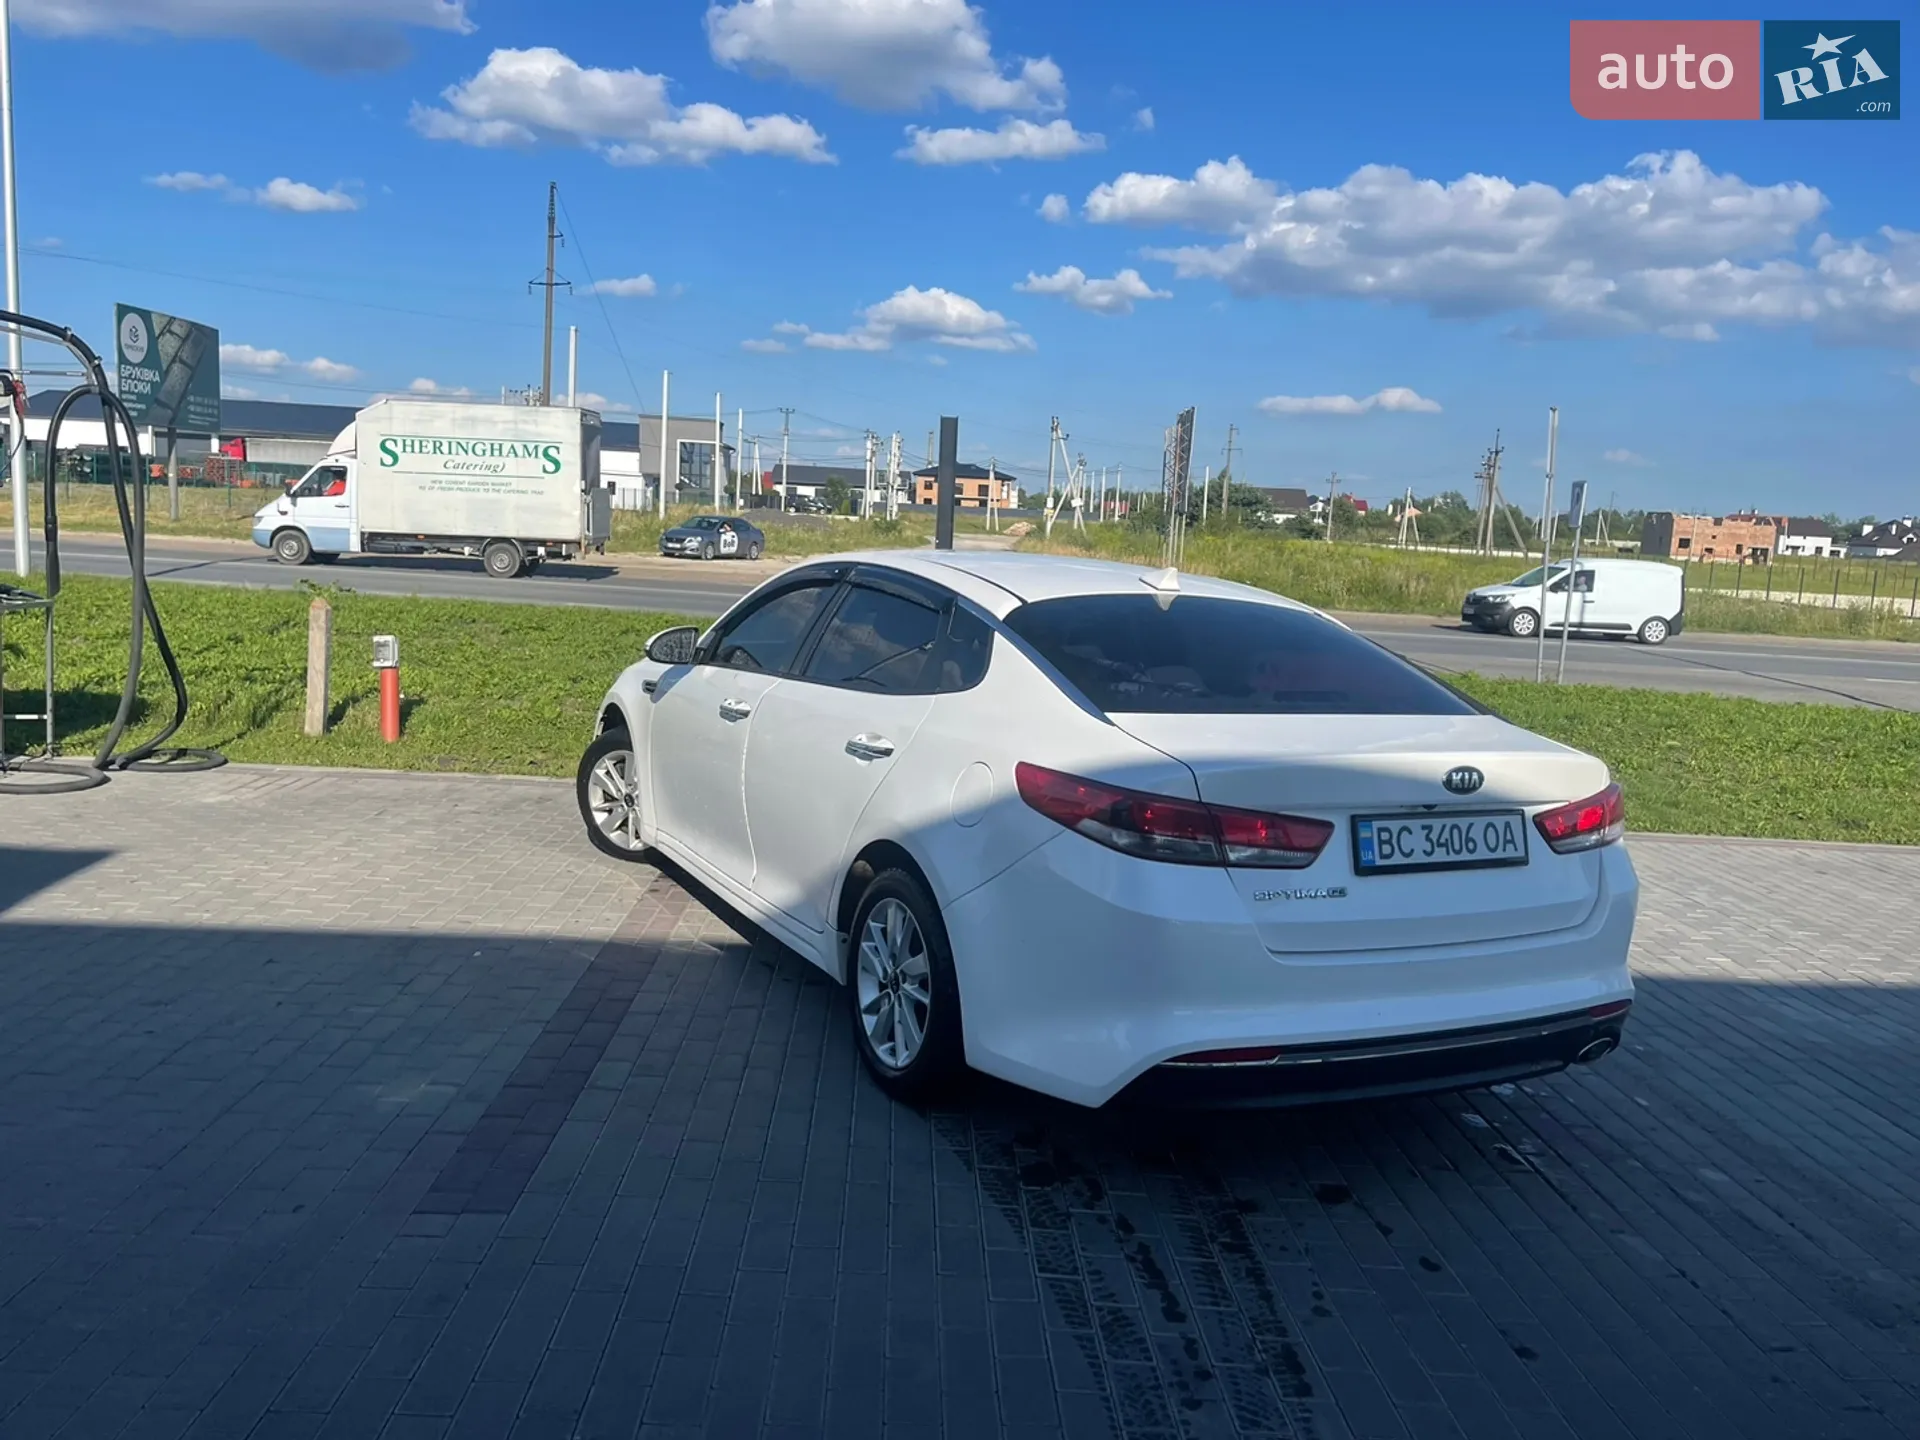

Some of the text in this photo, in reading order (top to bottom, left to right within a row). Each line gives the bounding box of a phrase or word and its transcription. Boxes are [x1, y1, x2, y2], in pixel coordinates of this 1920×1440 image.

[121, 364, 160, 383] БРУКІВКА
[121, 379, 152, 395] БЛОКИ
[379, 438, 562, 475] SHERINGHAMS
[1451, 771, 1480, 789] KIA
[1377, 820, 1519, 860] BC 3406 OA
[1361, 850, 1374, 861] UA
